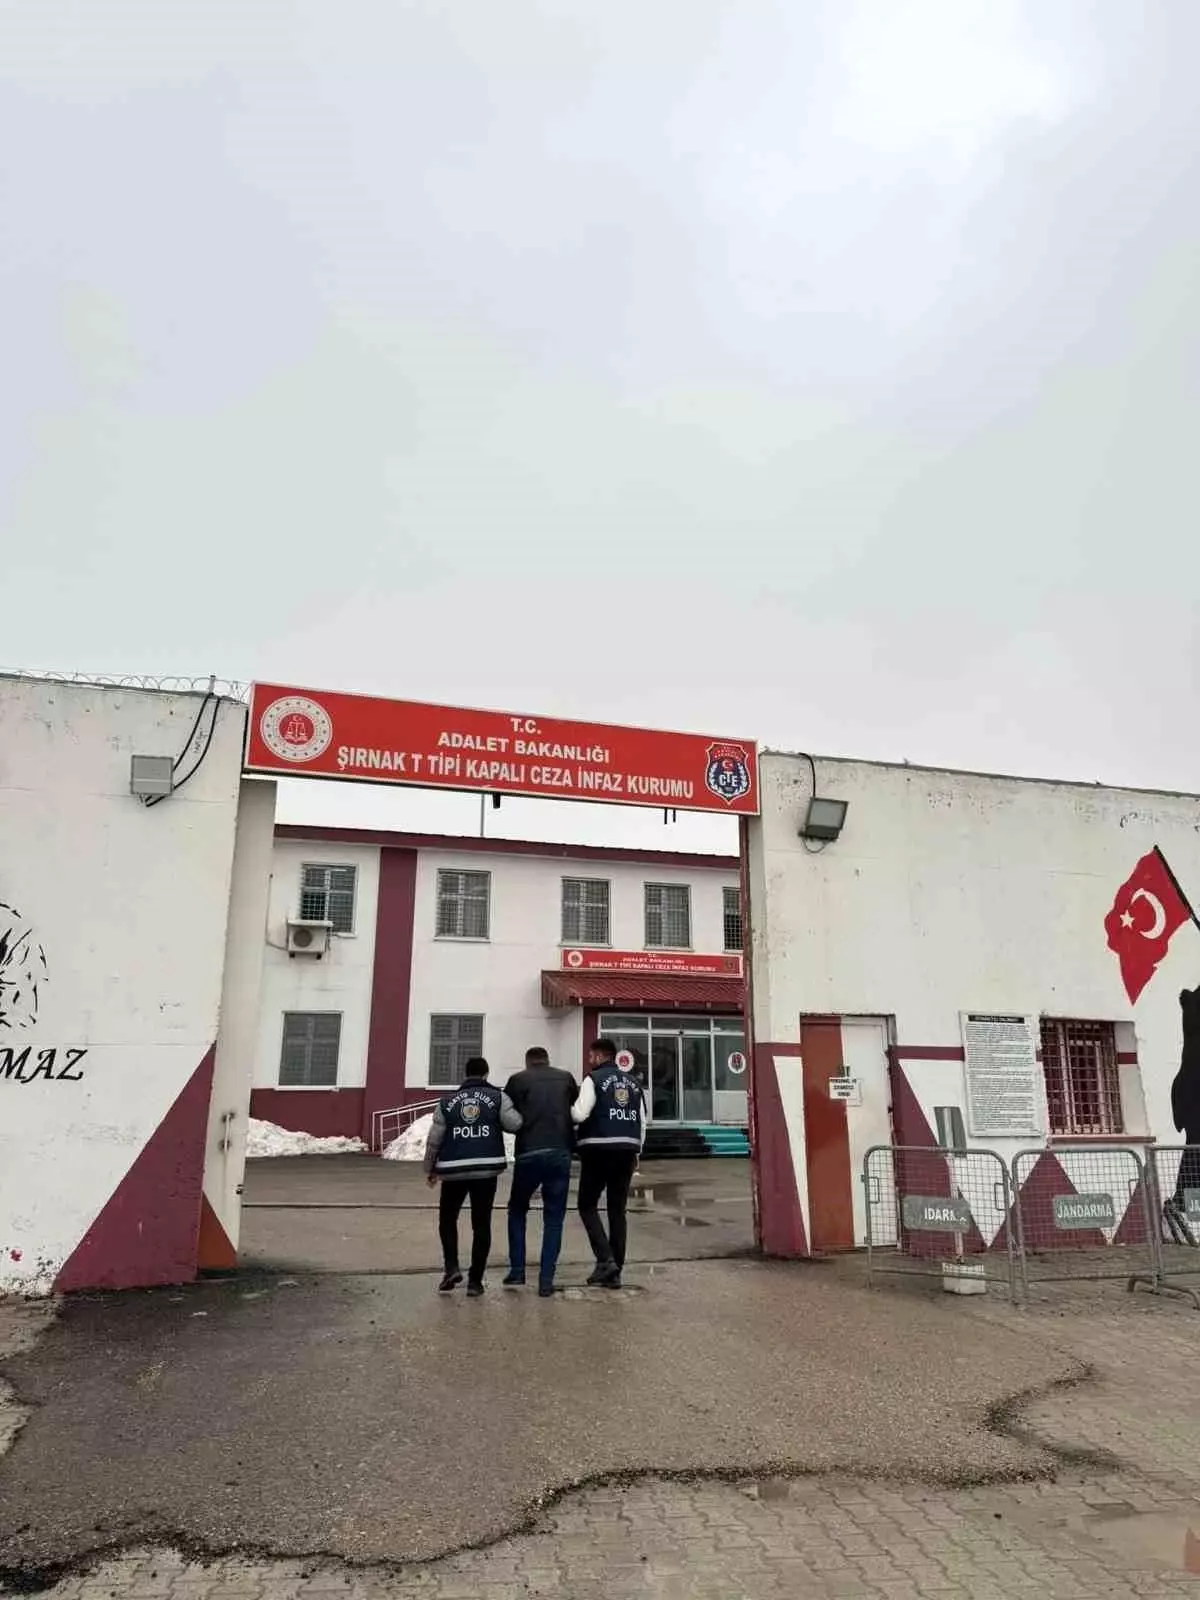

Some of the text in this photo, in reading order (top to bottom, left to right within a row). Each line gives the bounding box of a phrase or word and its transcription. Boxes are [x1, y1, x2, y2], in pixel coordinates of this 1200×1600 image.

[511, 718, 541, 734] T.C.
[438, 732, 609, 763] ADALET BAKANLIĞI
[337, 746, 693, 798] ŞIRNAK T TİPİ KAPALI CEZA İNFAZ KURUMU
[1057, 1204, 1113, 1218] JANDARMA
